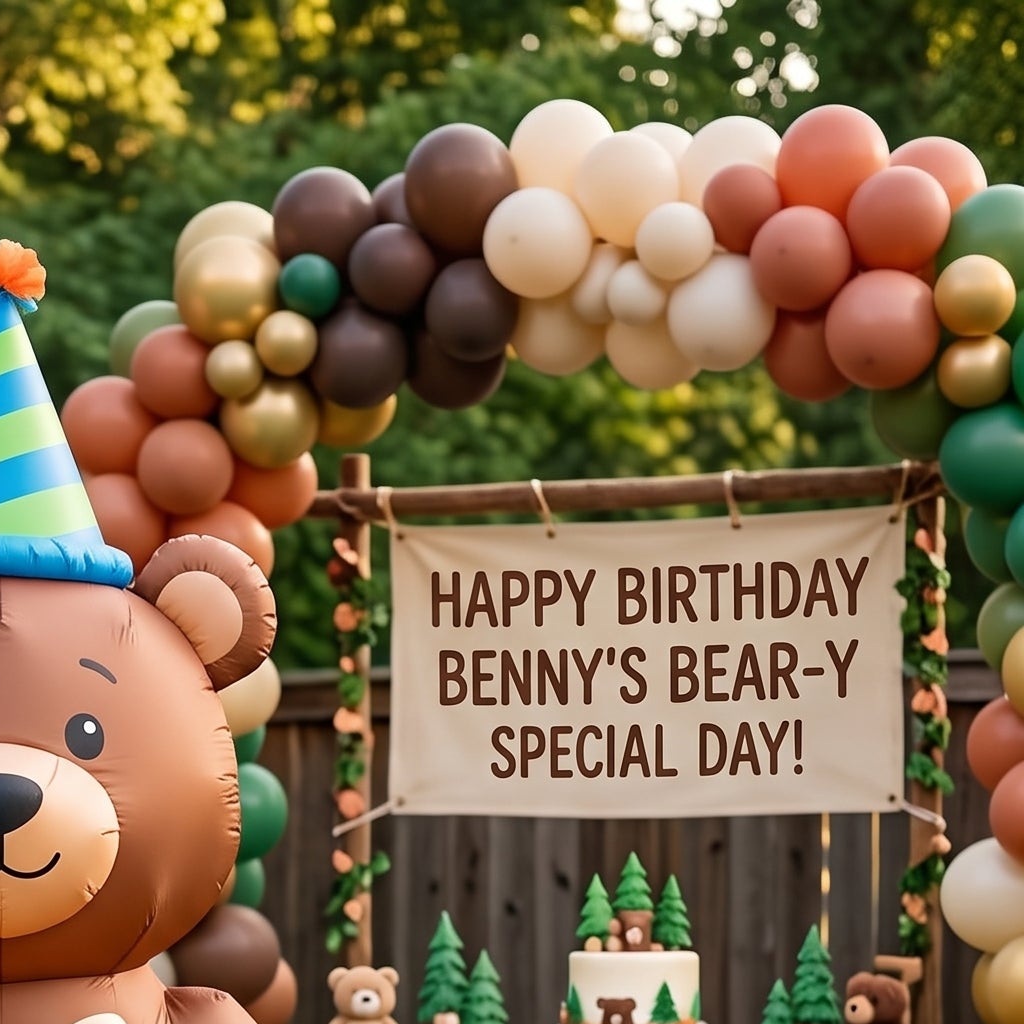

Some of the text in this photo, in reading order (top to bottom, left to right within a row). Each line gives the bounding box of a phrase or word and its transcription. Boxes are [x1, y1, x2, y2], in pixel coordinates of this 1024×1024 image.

[430, 556, 870, 627] HAPPY BIRTHDAY
[438, 639, 859, 706] BENNY'S BEAR-Y
[490, 719, 804, 778] SPECIAL DAY!
